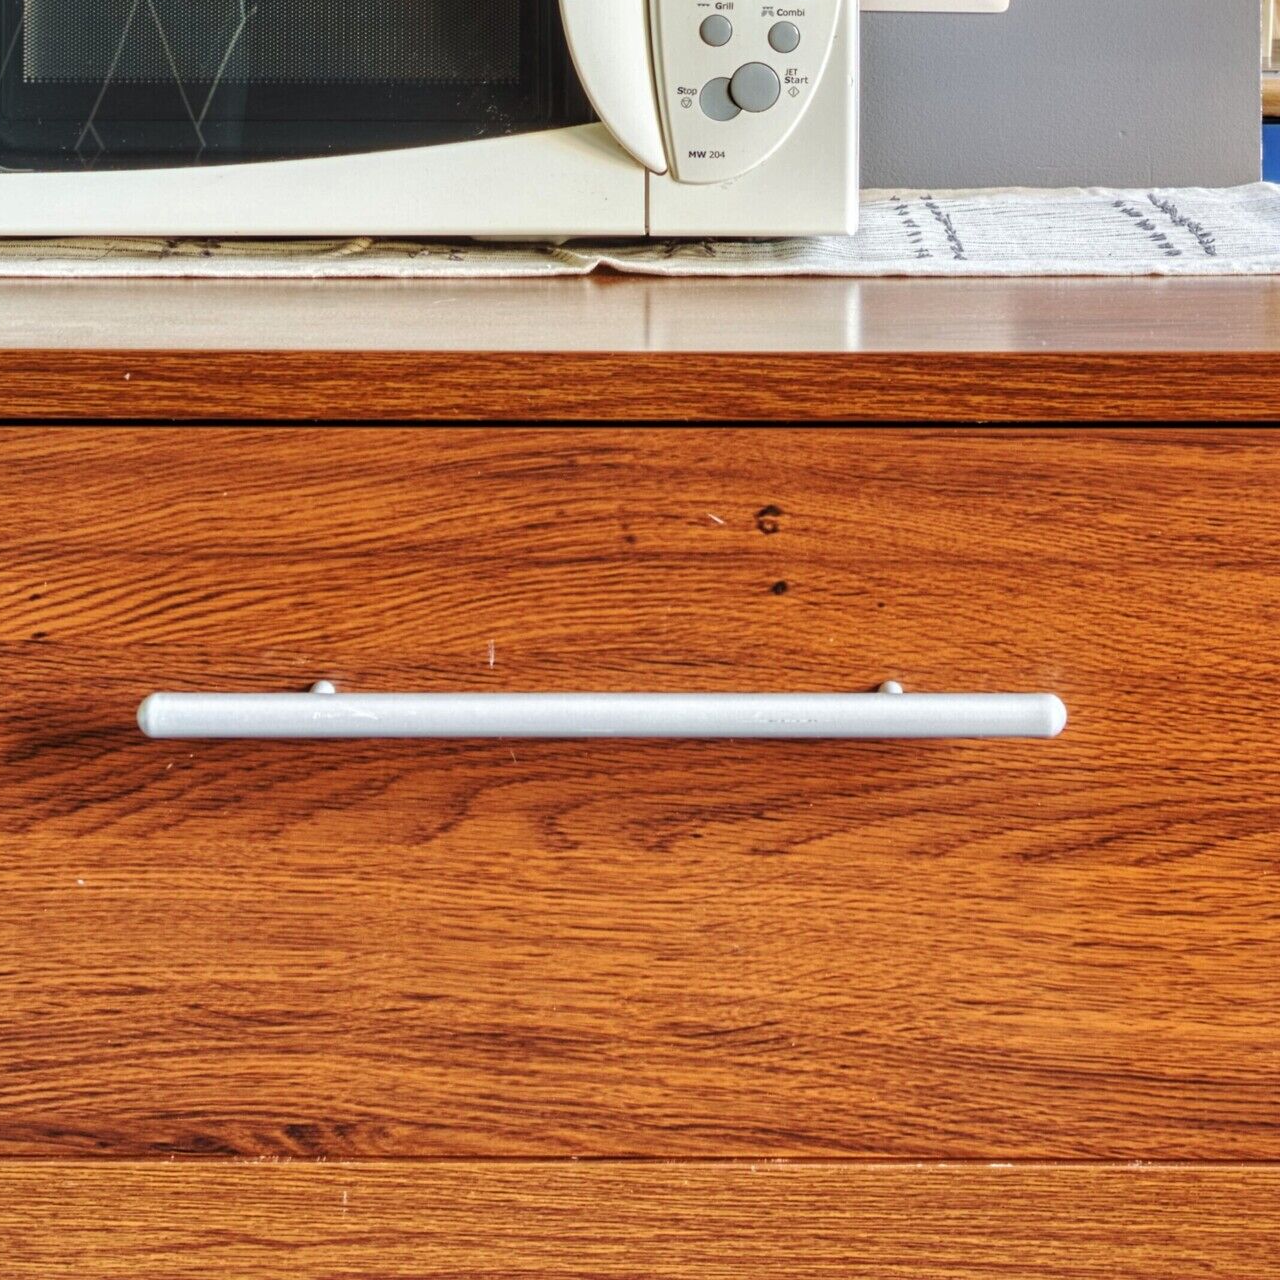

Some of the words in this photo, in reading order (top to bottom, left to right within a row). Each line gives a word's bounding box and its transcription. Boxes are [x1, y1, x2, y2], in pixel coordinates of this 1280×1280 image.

[715, 2, 734, 10] Grill
[776, 8, 805, 17] Combi
[785, 68, 798, 76] JET
[784, 76, 809, 84] Start
[677, 86, 697, 96] Stop
